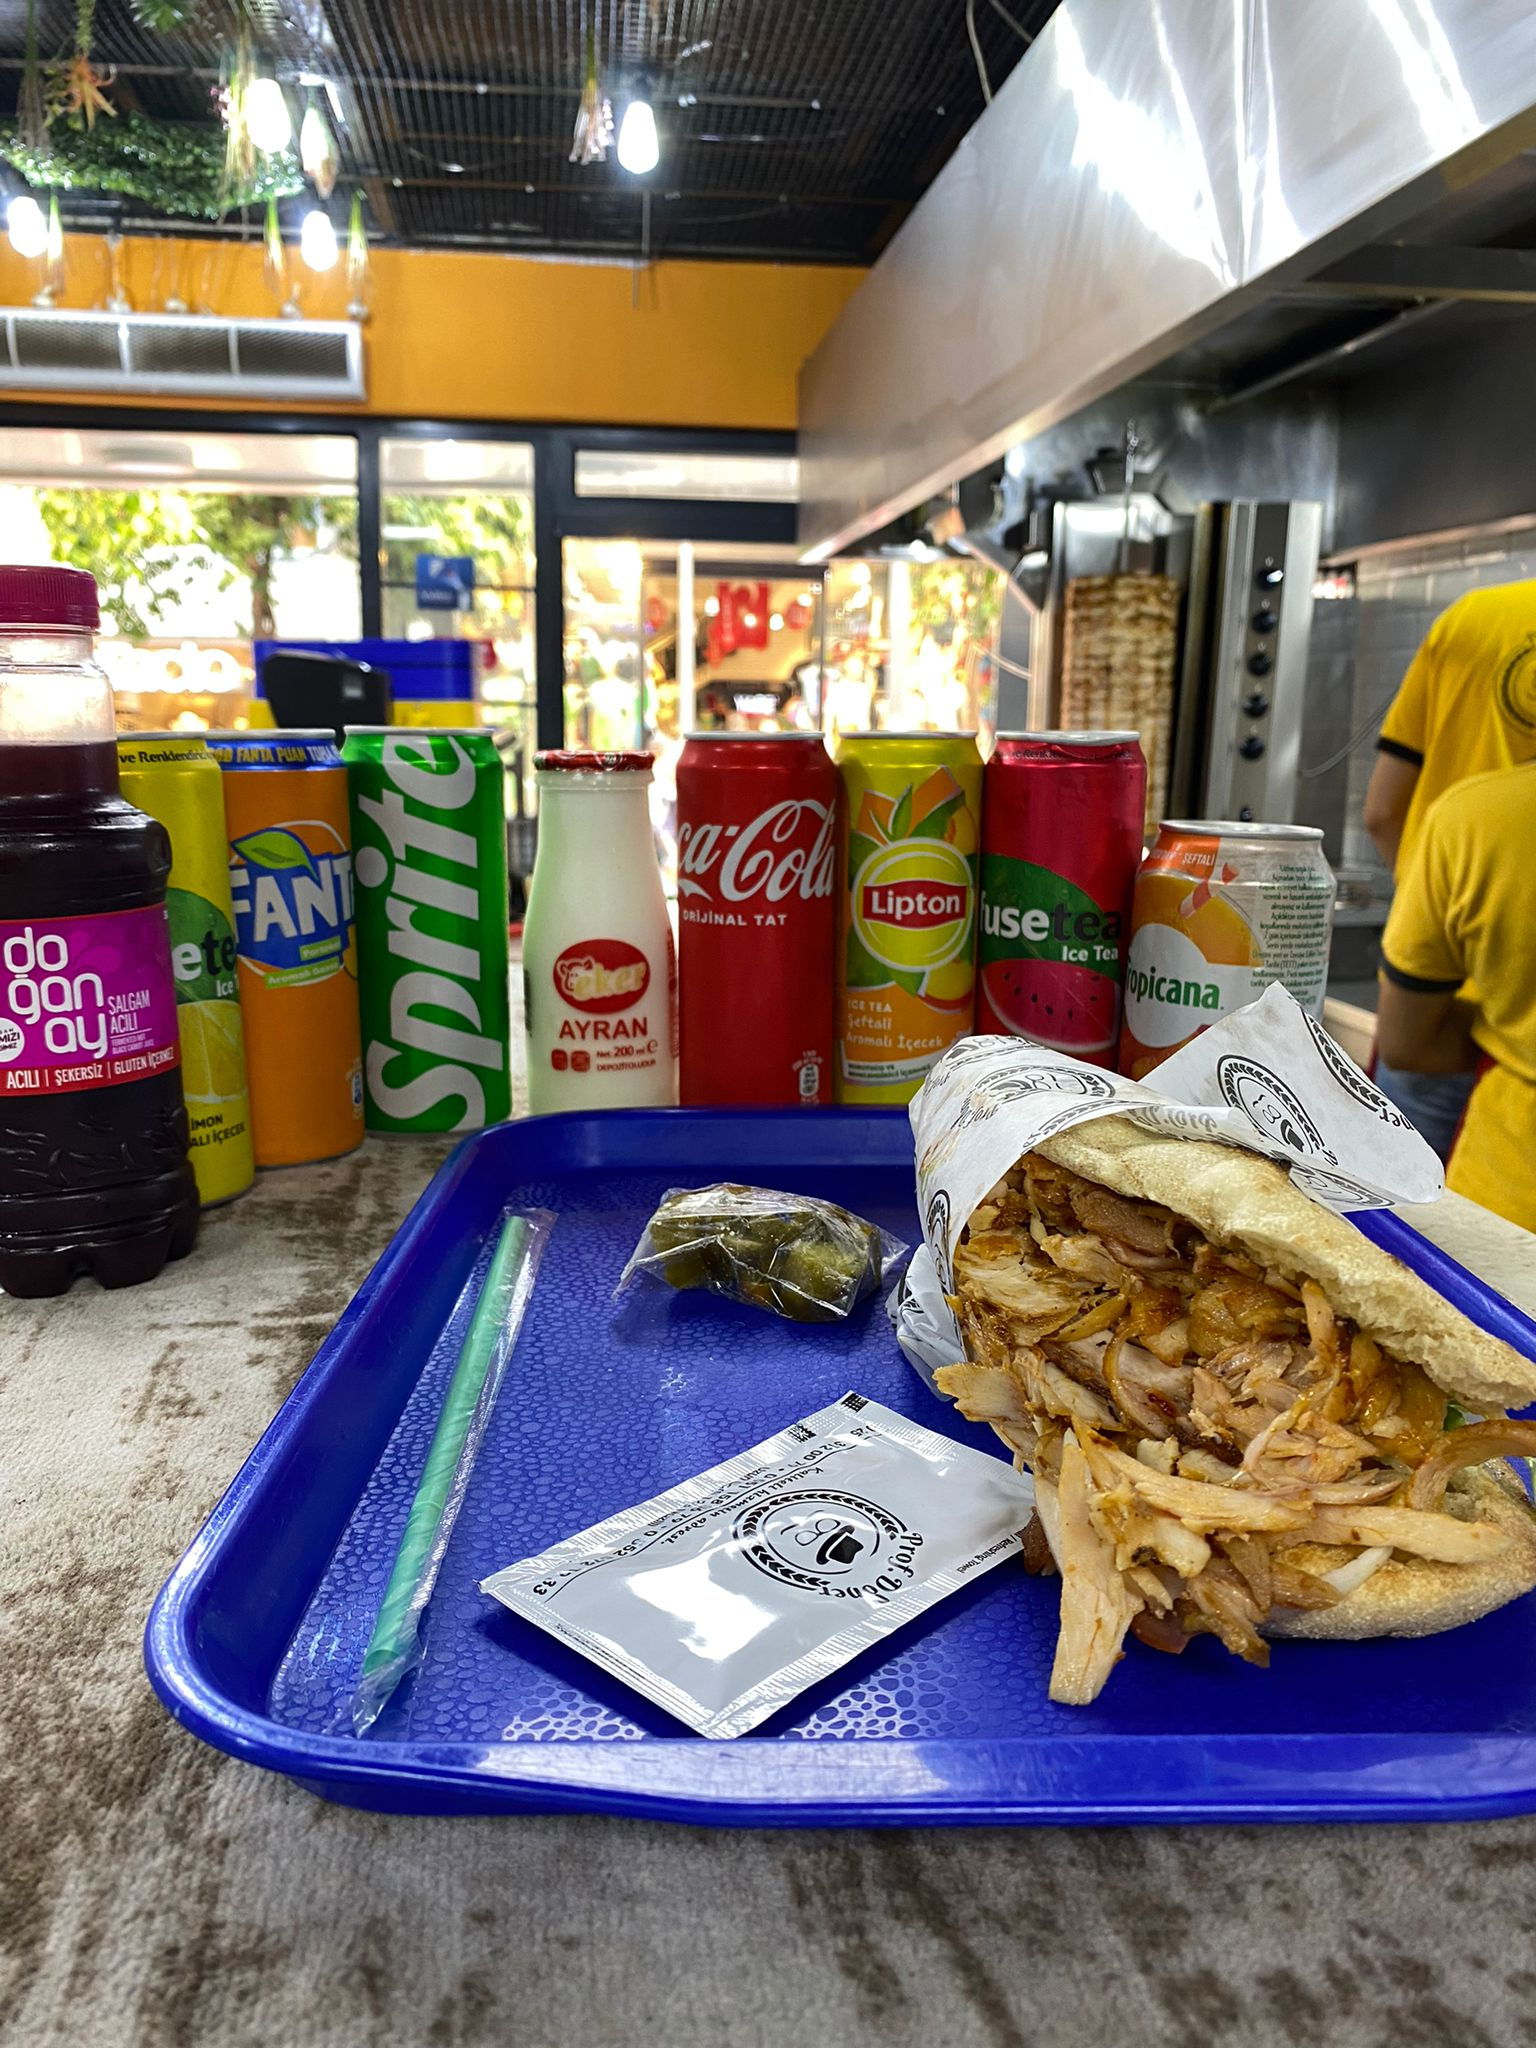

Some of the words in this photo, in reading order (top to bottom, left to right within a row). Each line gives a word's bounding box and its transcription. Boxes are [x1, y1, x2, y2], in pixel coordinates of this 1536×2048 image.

[119, 754, 136, 764] ve
[871, 890, 960, 921] Lipton
[754, 914, 787, 926] TAT
[355, 736, 503, 1132] Sprite
[1062, 946, 1088, 962] Ice
[1094, 945, 1118, 962] Tea
[216, 979, 234, 998] Ice
[870, 1002, 892, 1012] TEA
[111, 1012, 138, 1034] ACILI
[559, 1017, 648, 1040] AYRAN
[614, 1046, 635, 1057] 200
[114, 1055, 147, 1075] GLUTEN
[7, 1069, 40, 1089] ACILI
[55, 1063, 103, 1087] ŞEKERSİZ
[974, 1537, 1014, 1561] Refreshing
[956, 1559, 982, 1574] Towel
[533, 1577, 557, 1596] 33
